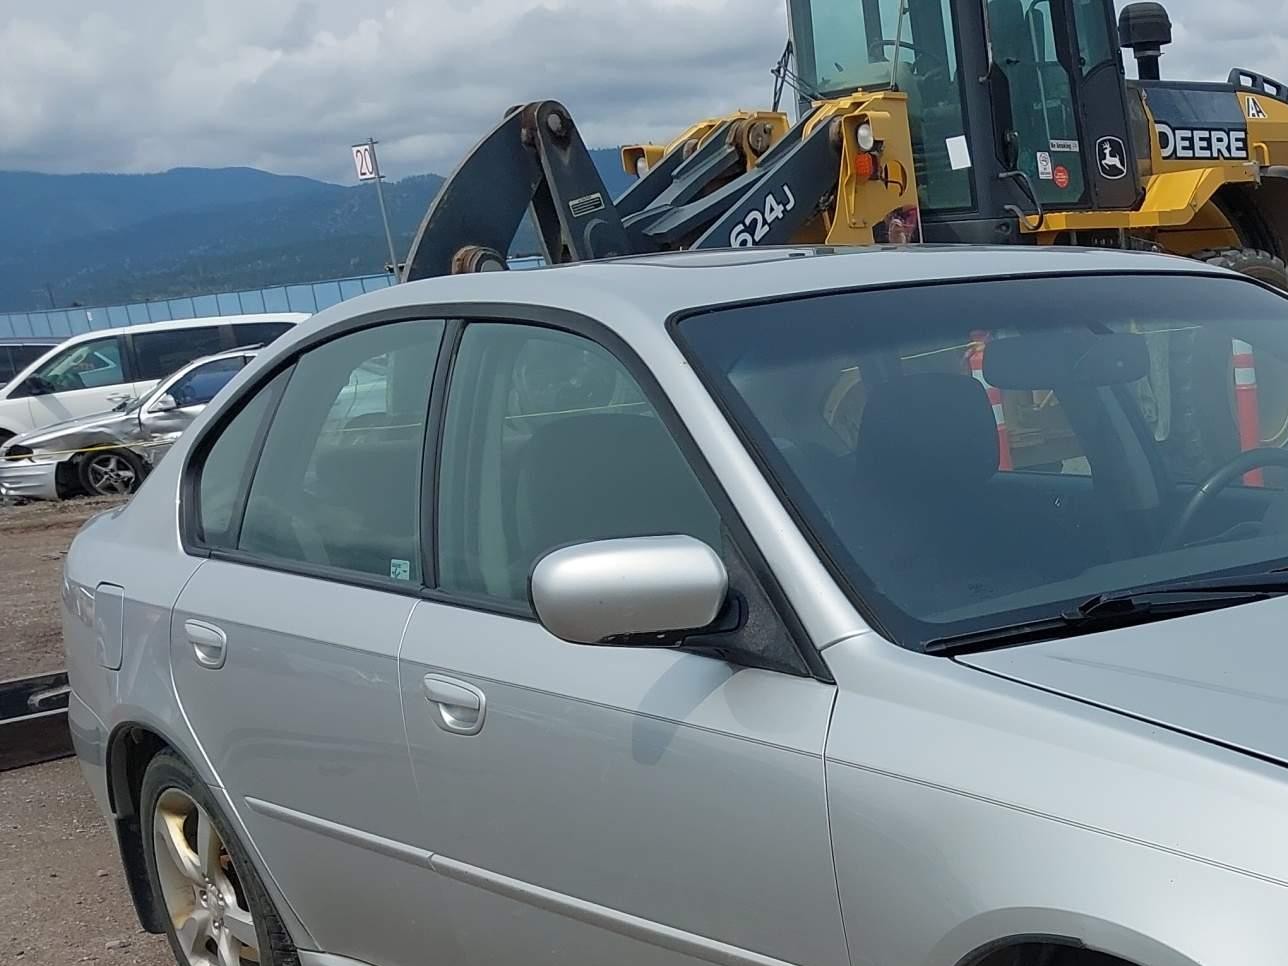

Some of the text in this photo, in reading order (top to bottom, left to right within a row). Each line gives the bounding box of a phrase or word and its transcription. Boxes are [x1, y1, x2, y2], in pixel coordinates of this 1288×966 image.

[1154, 123, 1247, 158] DEERE
[355, 148, 373, 176] 20
[730, 184, 795, 248] 624J
